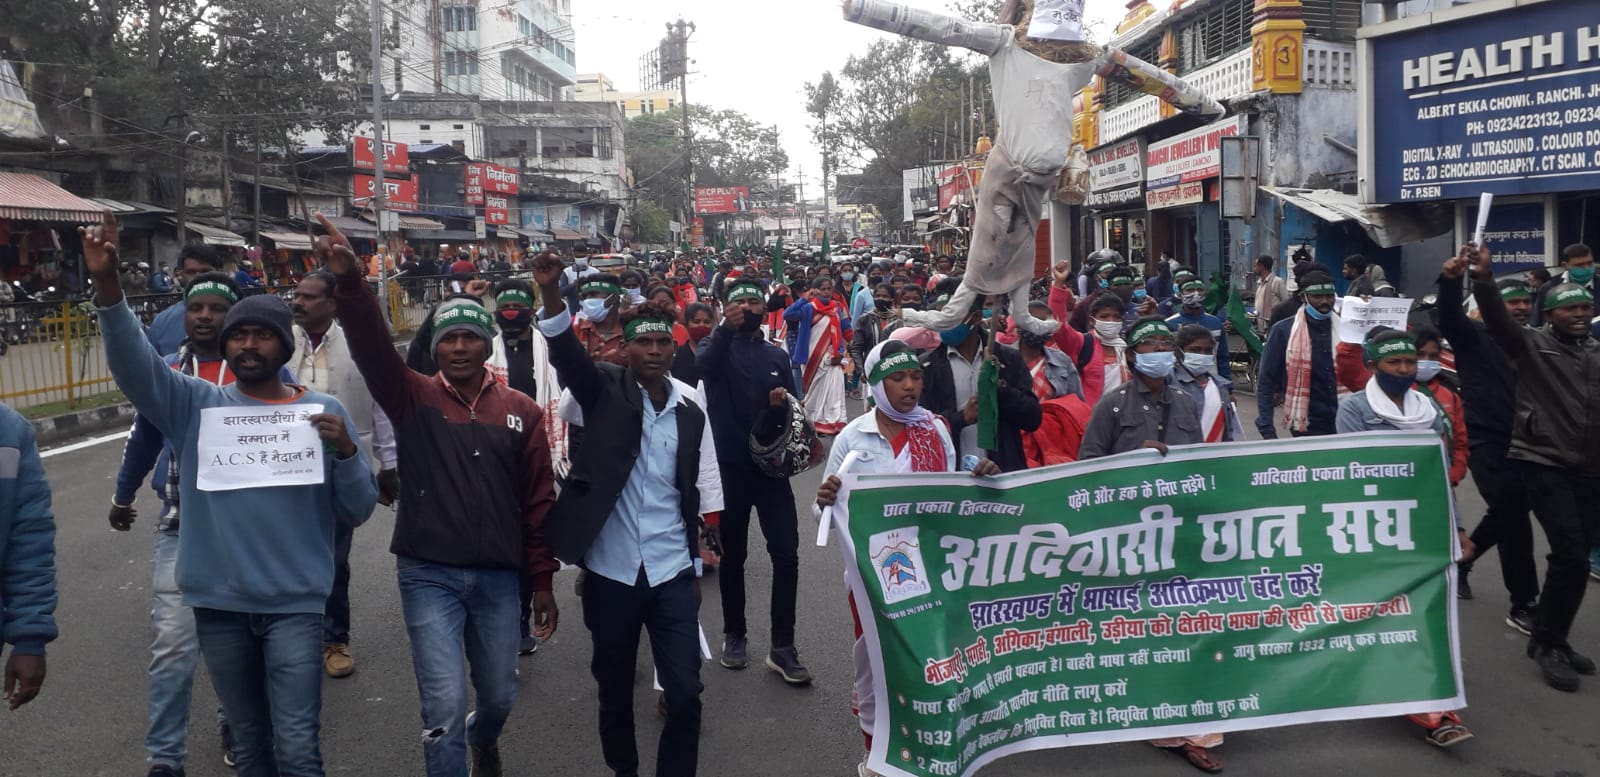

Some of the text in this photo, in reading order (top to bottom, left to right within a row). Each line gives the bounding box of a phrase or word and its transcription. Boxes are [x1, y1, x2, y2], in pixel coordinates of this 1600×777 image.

[1403, 31, 1564, 91] HEALTH
[1417, 103, 1456, 120] ALBERT
[1458, 98, 1488, 114] EKKA
[1466, 121, 1484, 136] PH:
[1487, 111, 1563, 133] 09234223132,
[1170, 135, 1205, 161] JEWELLERY
[1403, 147, 1435, 163] DIGITAL
[1437, 144, 1463, 160] X-RAY
[1472, 137, 1534, 157] ULTRASOUND
[1542, 132, 1583, 151] COLOUR
[1403, 167, 1420, 181] ECG
[1426, 165, 1438, 179] 2D
[1440, 157, 1536, 179] ECHOCARDIOGRAPHY
[1542, 155, 1555, 171] CT
[1557, 152, 1586, 170] SCAN
[507, 414, 523, 432] 03
[237, 430, 291, 445] सम्मान में
[271, 449, 301, 464] मैदान
[305, 447, 316, 460] में
[1250, 464, 1308, 486] आदिवासी
[1311, 465, 1345, 481] एकता
[1094, 485, 1116, 504] और
[1119, 486, 1138, 501] हक
[1141, 481, 1153, 498] के
[1155, 479, 1178, 497] लिए
[916, 501, 955, 514] एकता
[940, 484, 1418, 592] आदिवासी छात्र संघ
[968, 564, 1323, 630] झारखण्ड में भाषाई अतिक्रमण बंद करें
[1149, 613, 1173, 636] को
[1227, 610, 1261, 631] भाषा
[1262, 603, 1284, 626] की
[1319, 600, 1340, 624] से
[1339, 602, 1377, 623] बाहर
[1258, 642, 1294, 655] सरकार
[1298, 638, 1325, 652] 1932
[1329, 635, 1355, 652] लागू
[1378, 630, 1418, 644] सरकार
[912, 700, 942, 715] भाषा
[1066, 653, 1095, 671] बाहरी
[1099, 653, 1125, 668] भाषा
[1128, 648, 1150, 666] नहीं
[916, 730, 952, 746] 1932
[1042, 683, 1070, 702] नीति
[1074, 684, 1102, 702] लागू
[917, 756, 926, 769] 2
[928, 758, 957, 776] लाख
[1106, 705, 1149, 726] नियुक्ति
[1152, 702, 1188, 720] प्रक्रिया
